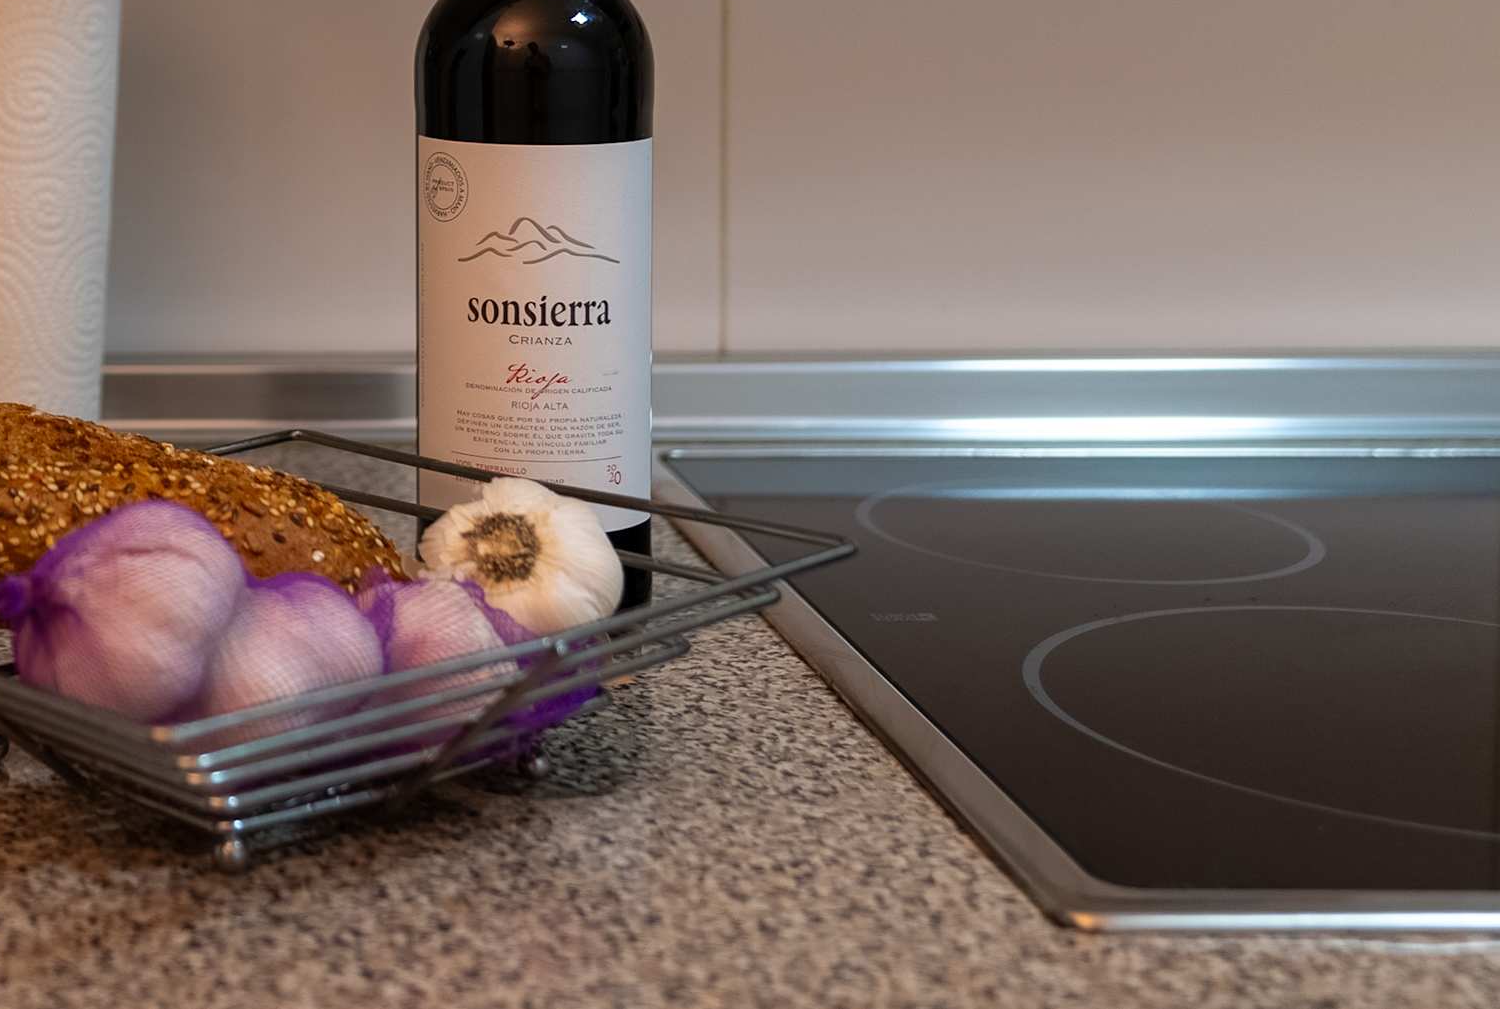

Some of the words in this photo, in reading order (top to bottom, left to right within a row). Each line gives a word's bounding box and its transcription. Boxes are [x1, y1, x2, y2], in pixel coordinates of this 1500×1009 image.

[506, 363, 571, 400] Rioja
[466, 382, 523, 393] DENOMINACIÓN
[571, 385, 612, 395] CALIFICADA
[512, 400, 540, 412] RIOJA
[543, 402, 569, 411] ALTA
[550, 424, 568, 432] UNA
[476, 463, 527, 475] TEMPRANILLO
